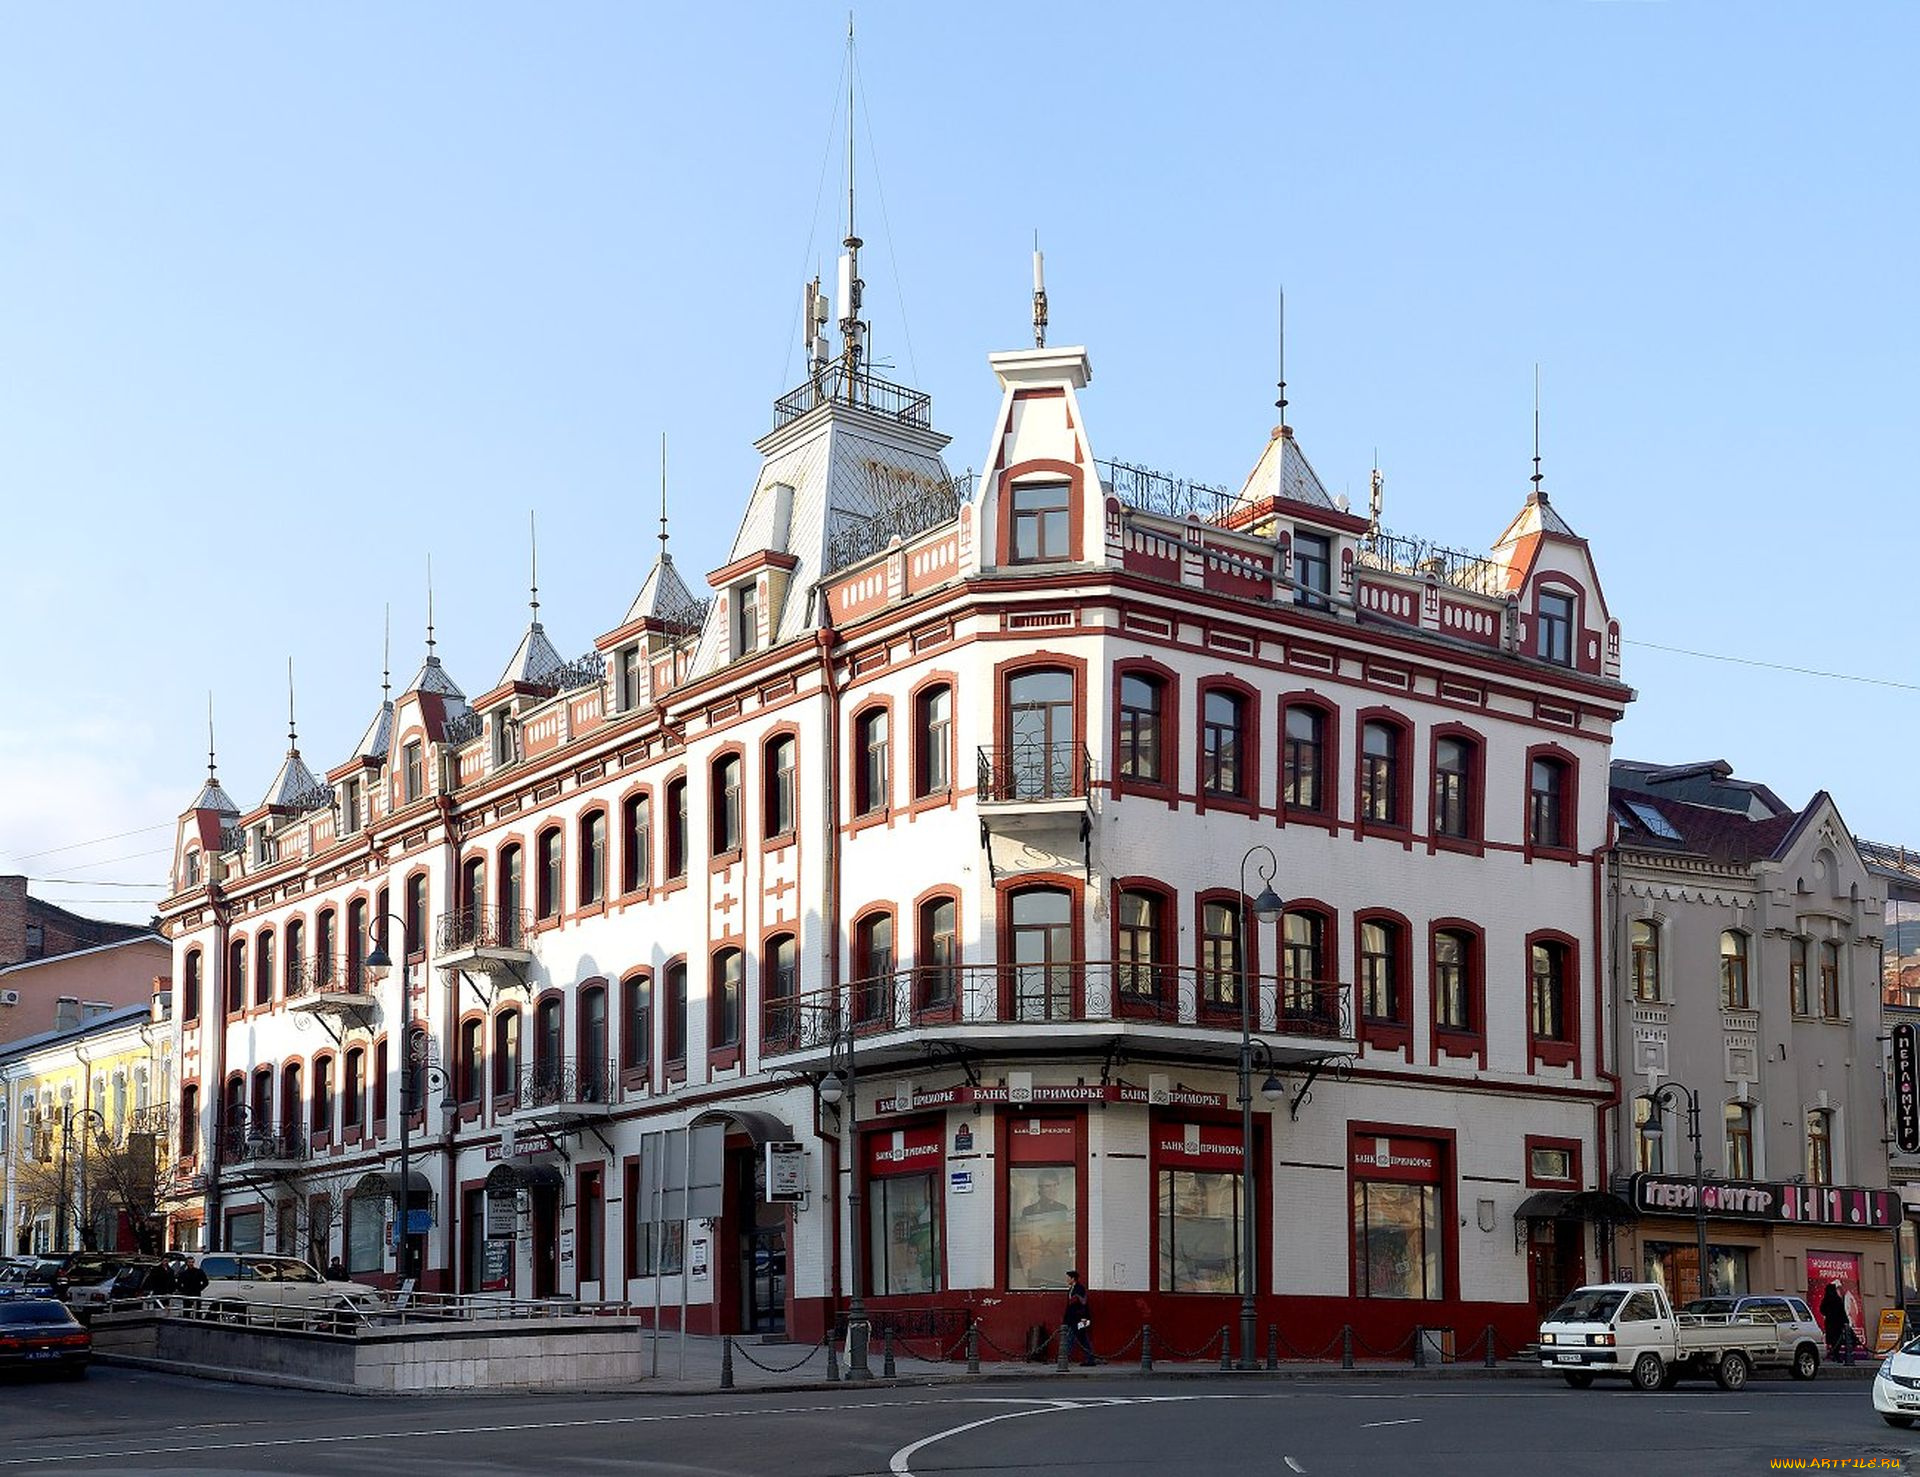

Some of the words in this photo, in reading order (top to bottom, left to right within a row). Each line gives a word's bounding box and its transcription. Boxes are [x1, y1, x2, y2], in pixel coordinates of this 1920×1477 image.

[913, 1090, 955, 1106] ПРИМОРЬЕ
[973, 1089, 1008, 1100] БАНК
[1033, 1088, 1104, 1100] ПРИМОРЬЕ
[1120, 1089, 1148, 1100] БАНК
[1169, 1092, 1221, 1106] ПРИМОРЬЕ
[1161, 1141, 1185, 1151] БАНК
[1355, 1154, 1376, 1163] БАНК
[1390, 1156, 1432, 1168] ПРИМОРЬЕ
